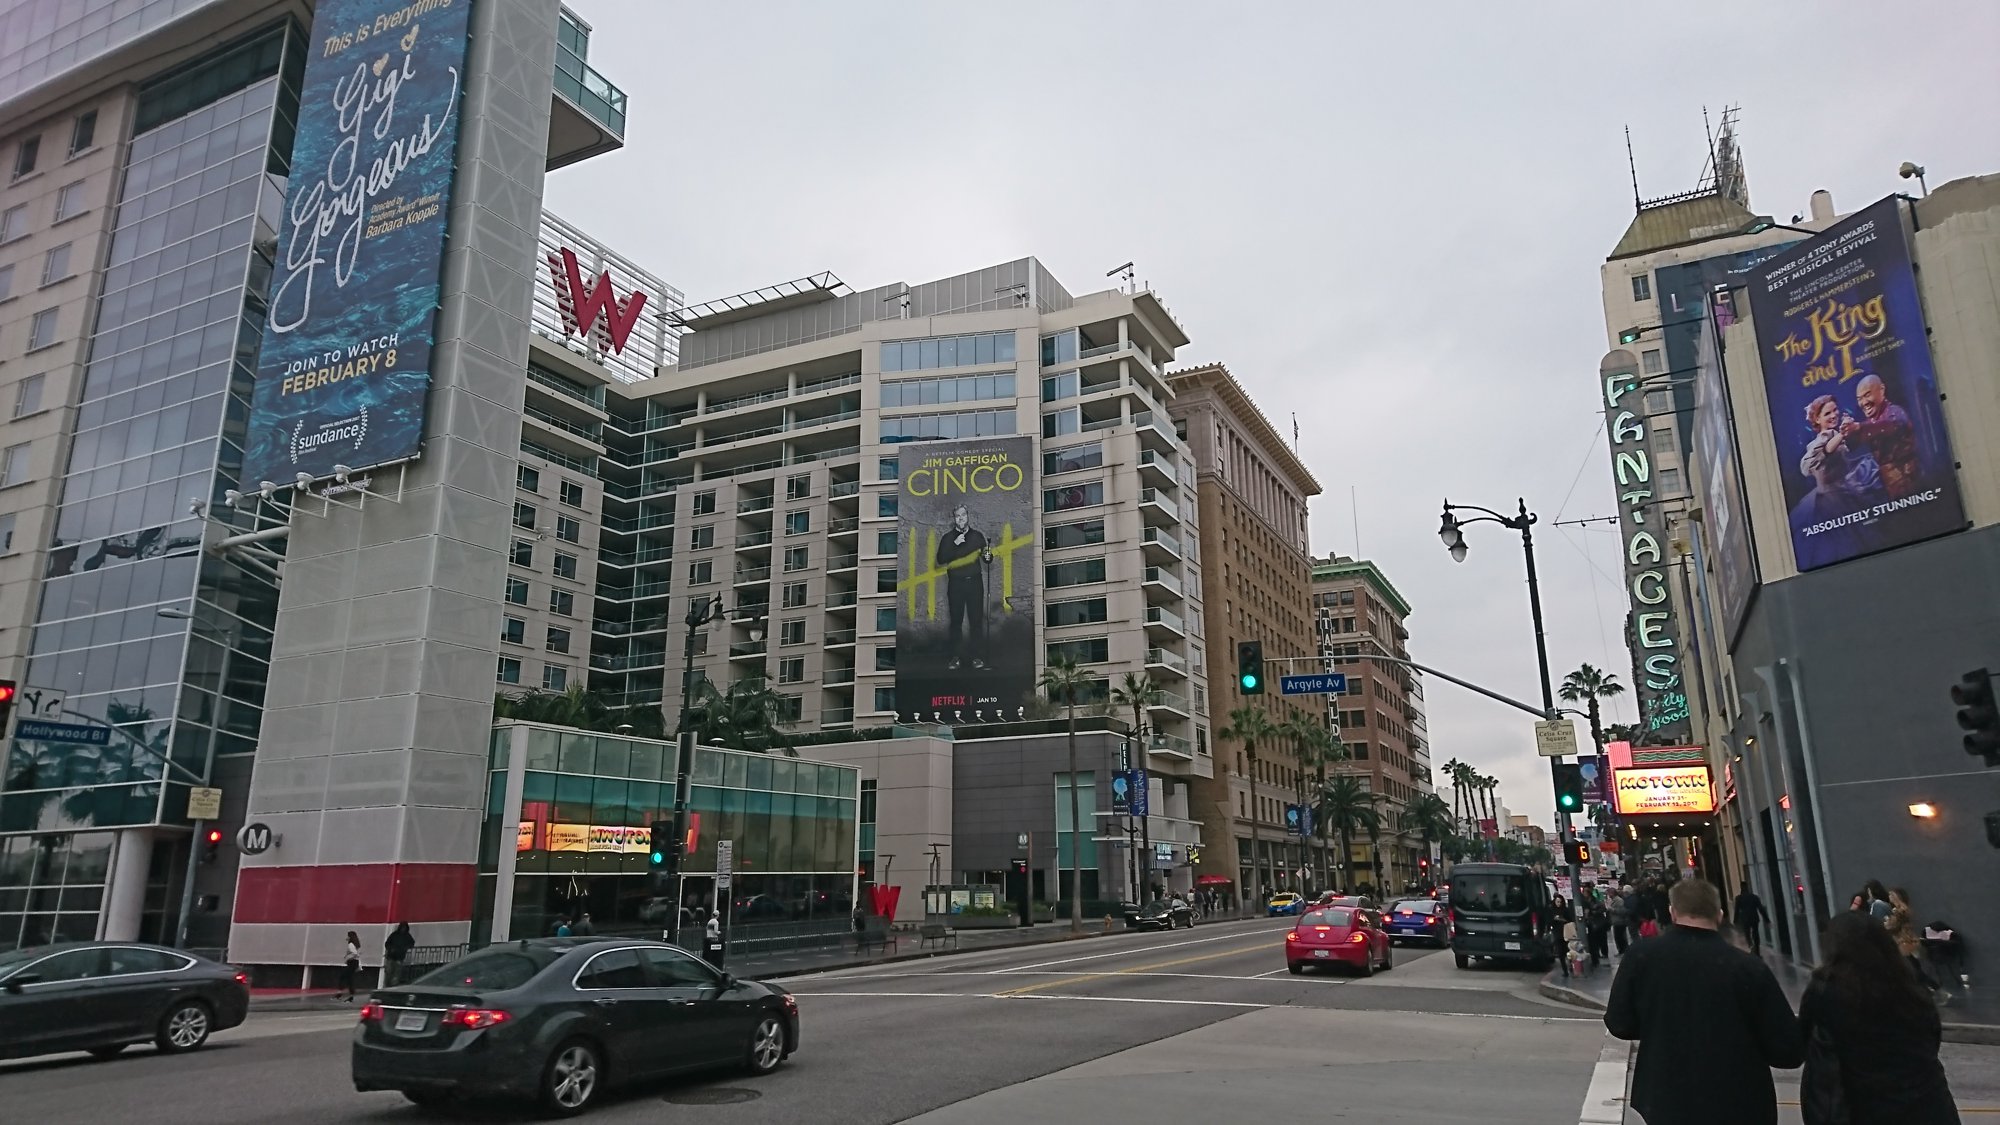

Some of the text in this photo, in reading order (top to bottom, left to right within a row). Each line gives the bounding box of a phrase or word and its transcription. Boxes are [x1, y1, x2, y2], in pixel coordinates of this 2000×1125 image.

[323, 31, 352, 58] This
[356, 24, 370, 43] is
[328, 54, 416, 191] Gigi
[270, 66, 458, 333] Gorgeous
[365, 203, 439, 239] Barbara Kopple
[1765, 261, 1796, 281] WINNER
[1797, 256, 1806, 265] OF
[1807, 251, 1814, 259] 4
[1814, 238, 1838, 256] TONY
[1839, 220, 1875, 244] AWARDS
[1767, 277, 1789, 293] BEST
[1792, 255, 1834, 280] MUSICAL
[1836, 232, 1878, 257] REVIVAL
[1783, 299, 1814, 318] RODGERS
[1819, 269, 1876, 300] HAMMERSTEIN'S
[1789, 258, 1863, 297] THE LINCOLN CENTER
[1789, 263, 1865, 303] THEATER PRODUCTION
[560, 246, 648, 356] W
[1774, 294, 1886, 365] The King
[281, 349, 397, 396] FEBRUARY 8
[284, 333, 399, 375] JOIN TO WATCH
[1802, 335, 1864, 388] and I
[298, 424, 359, 449] sundance
[907, 463, 1023, 496] CINCO
[922, 453, 1008, 468] JIM GAFFIGAN
[1802, 487, 1942, 537] "ABSOLUTELY STUNNING."
[931, 695, 965, 707] NETFLIX
[1287, 678, 1340, 692] Argyle Av
[22, 724, 88, 739] Hollywood
[1330, 692, 1341, 737] BLD
[1620, 774, 1707, 790] MOTOWN
[247, 828, 268, 849] M
[1580, 846, 1588, 860] 6
